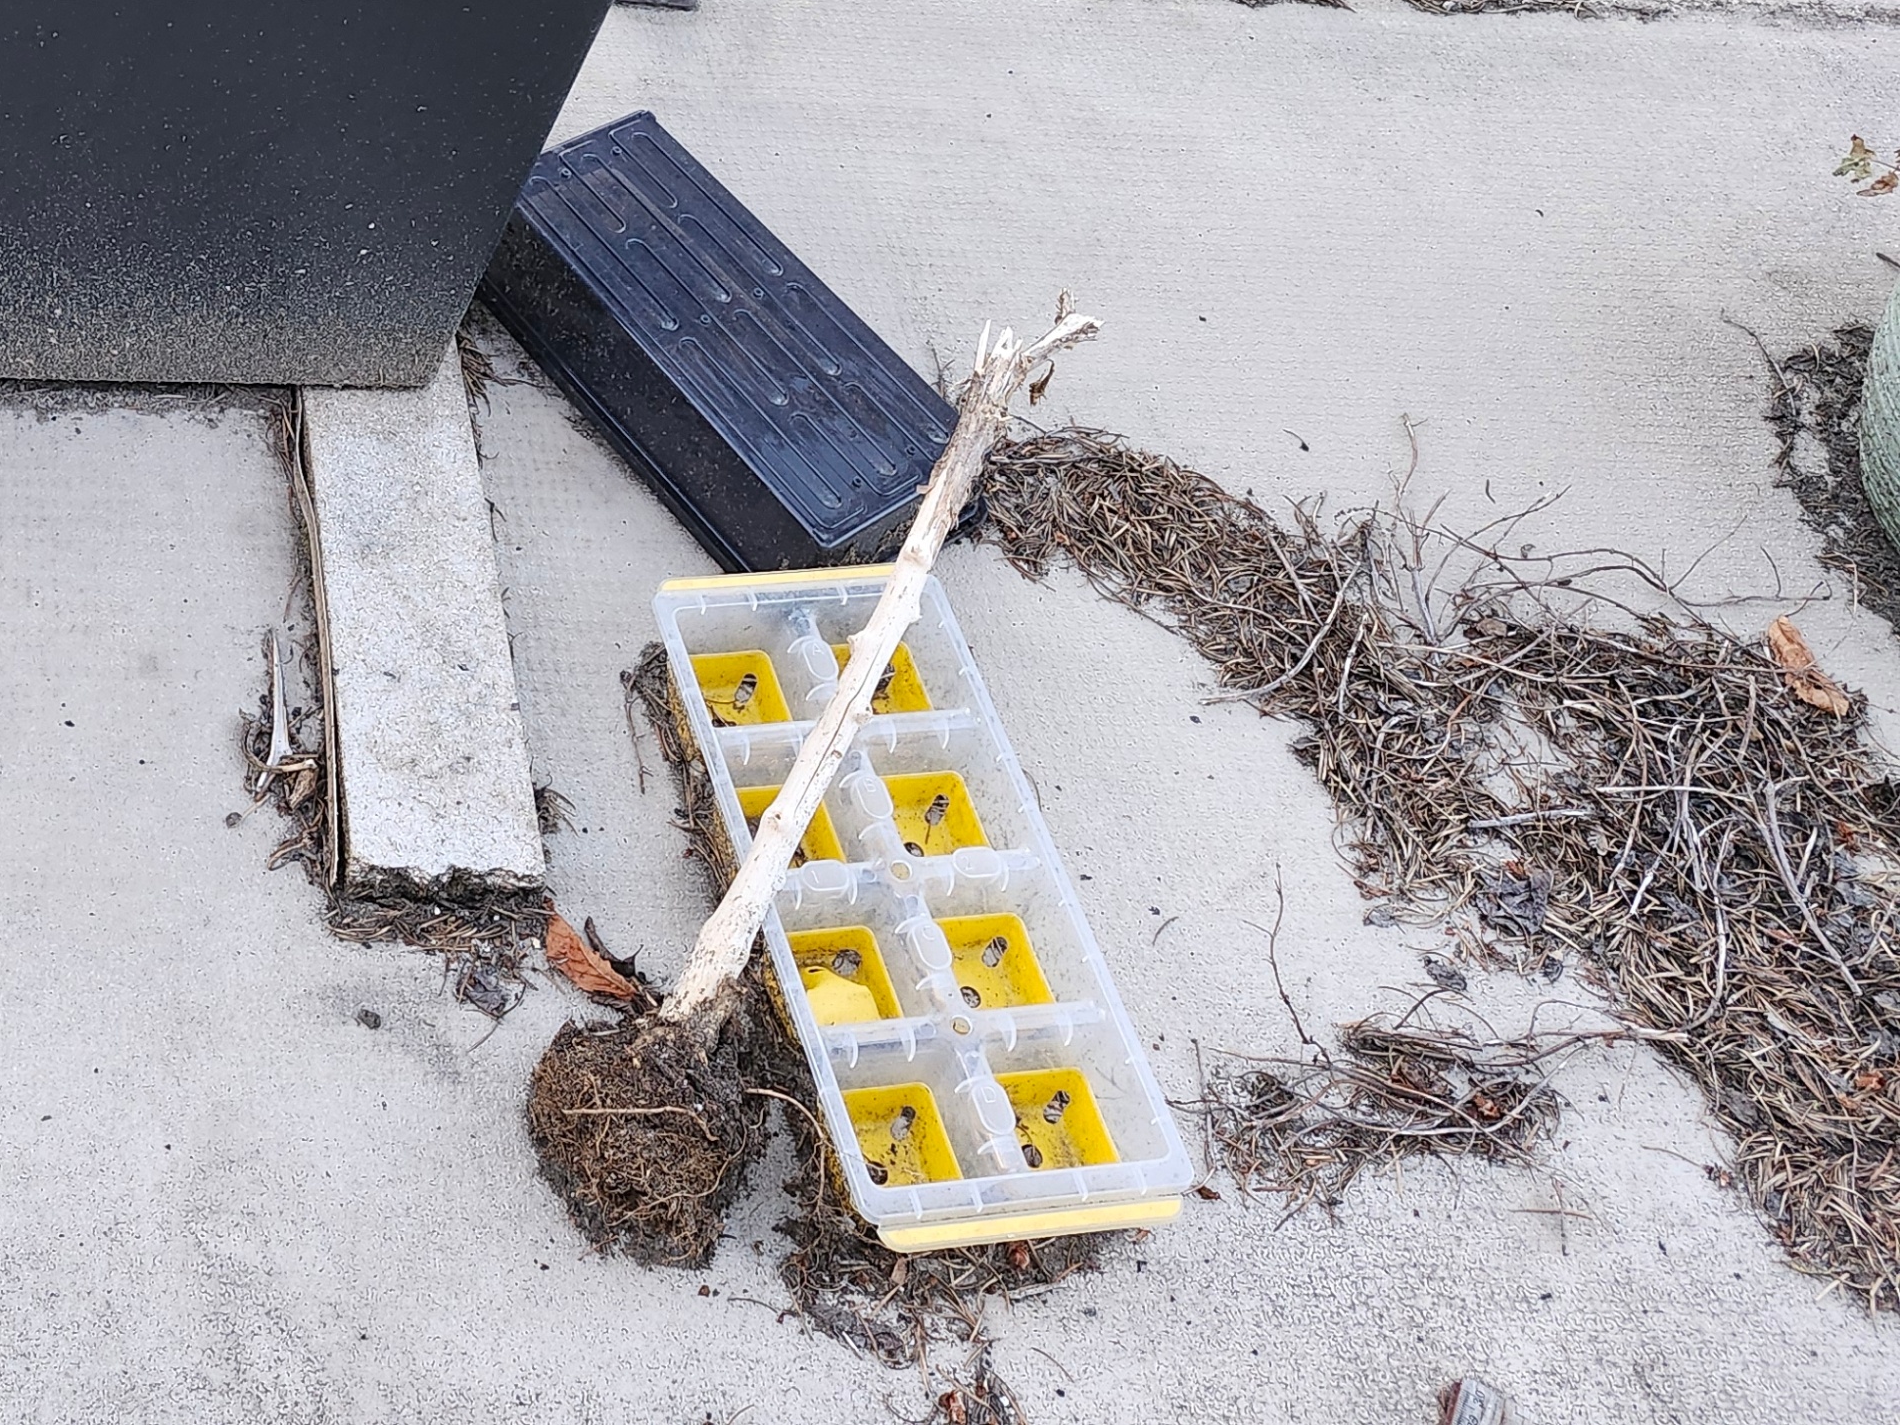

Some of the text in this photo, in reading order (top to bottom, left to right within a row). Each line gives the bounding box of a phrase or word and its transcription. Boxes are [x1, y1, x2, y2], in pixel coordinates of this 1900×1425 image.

[812, 642, 825, 656] A
[863, 777, 877, 793] B
[922, 925, 936, 941] C
[980, 1085, 996, 1104] D
